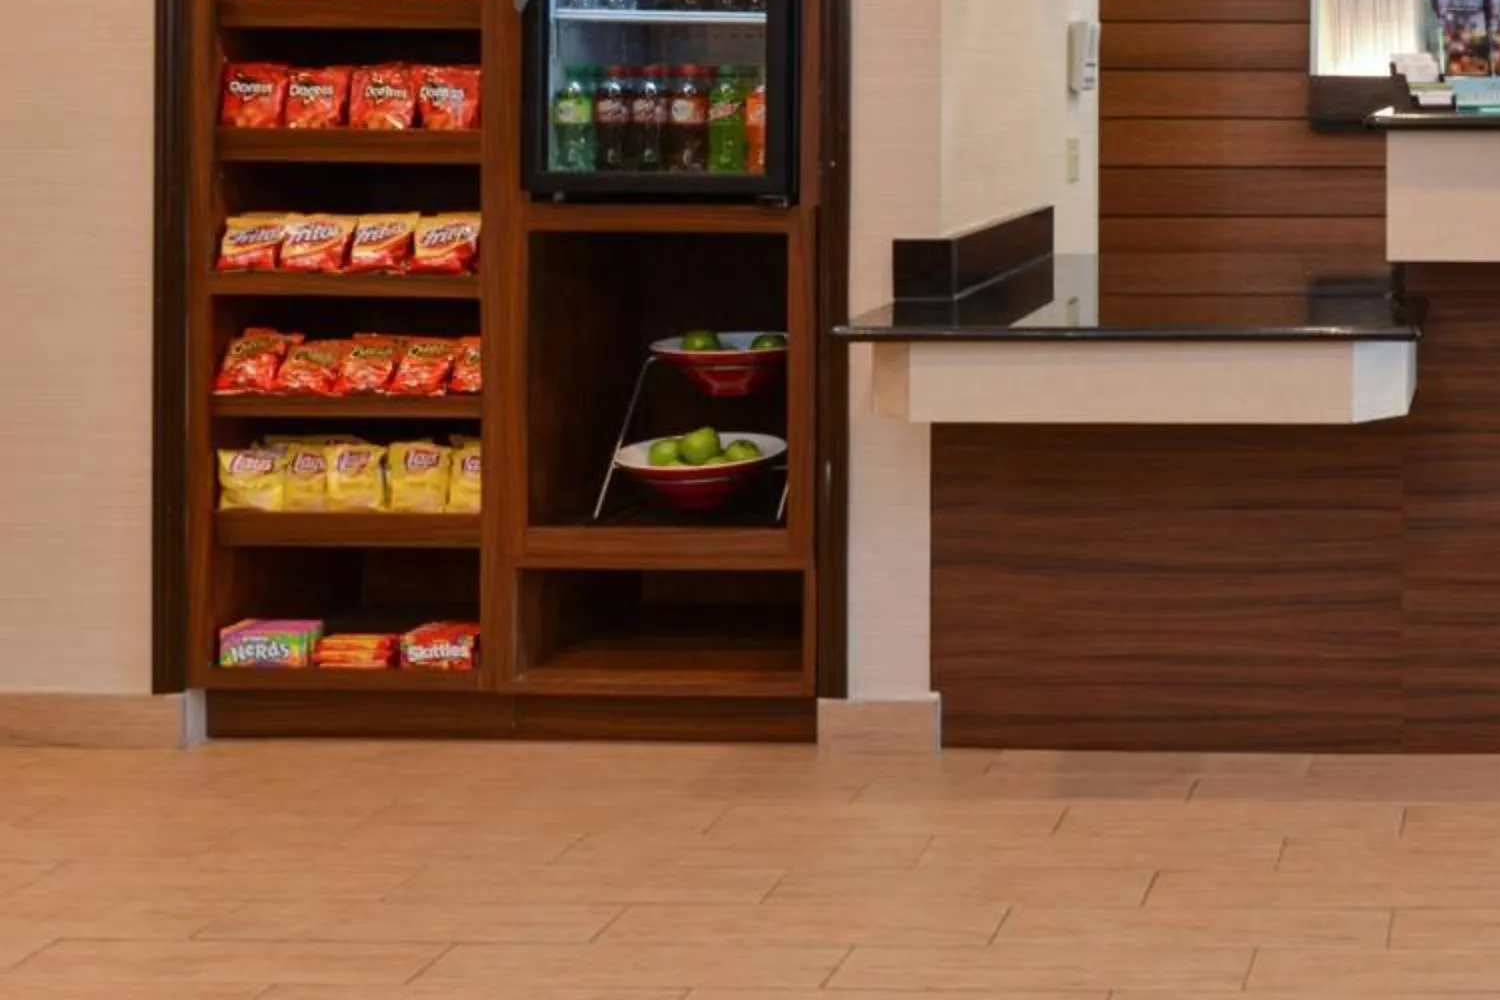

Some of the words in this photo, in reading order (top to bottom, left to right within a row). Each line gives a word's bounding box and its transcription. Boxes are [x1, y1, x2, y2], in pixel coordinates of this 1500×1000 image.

[228, 80, 273, 98] Doritos
[289, 82, 334, 98] Doritos
[407, 642, 470, 662] Skittles
